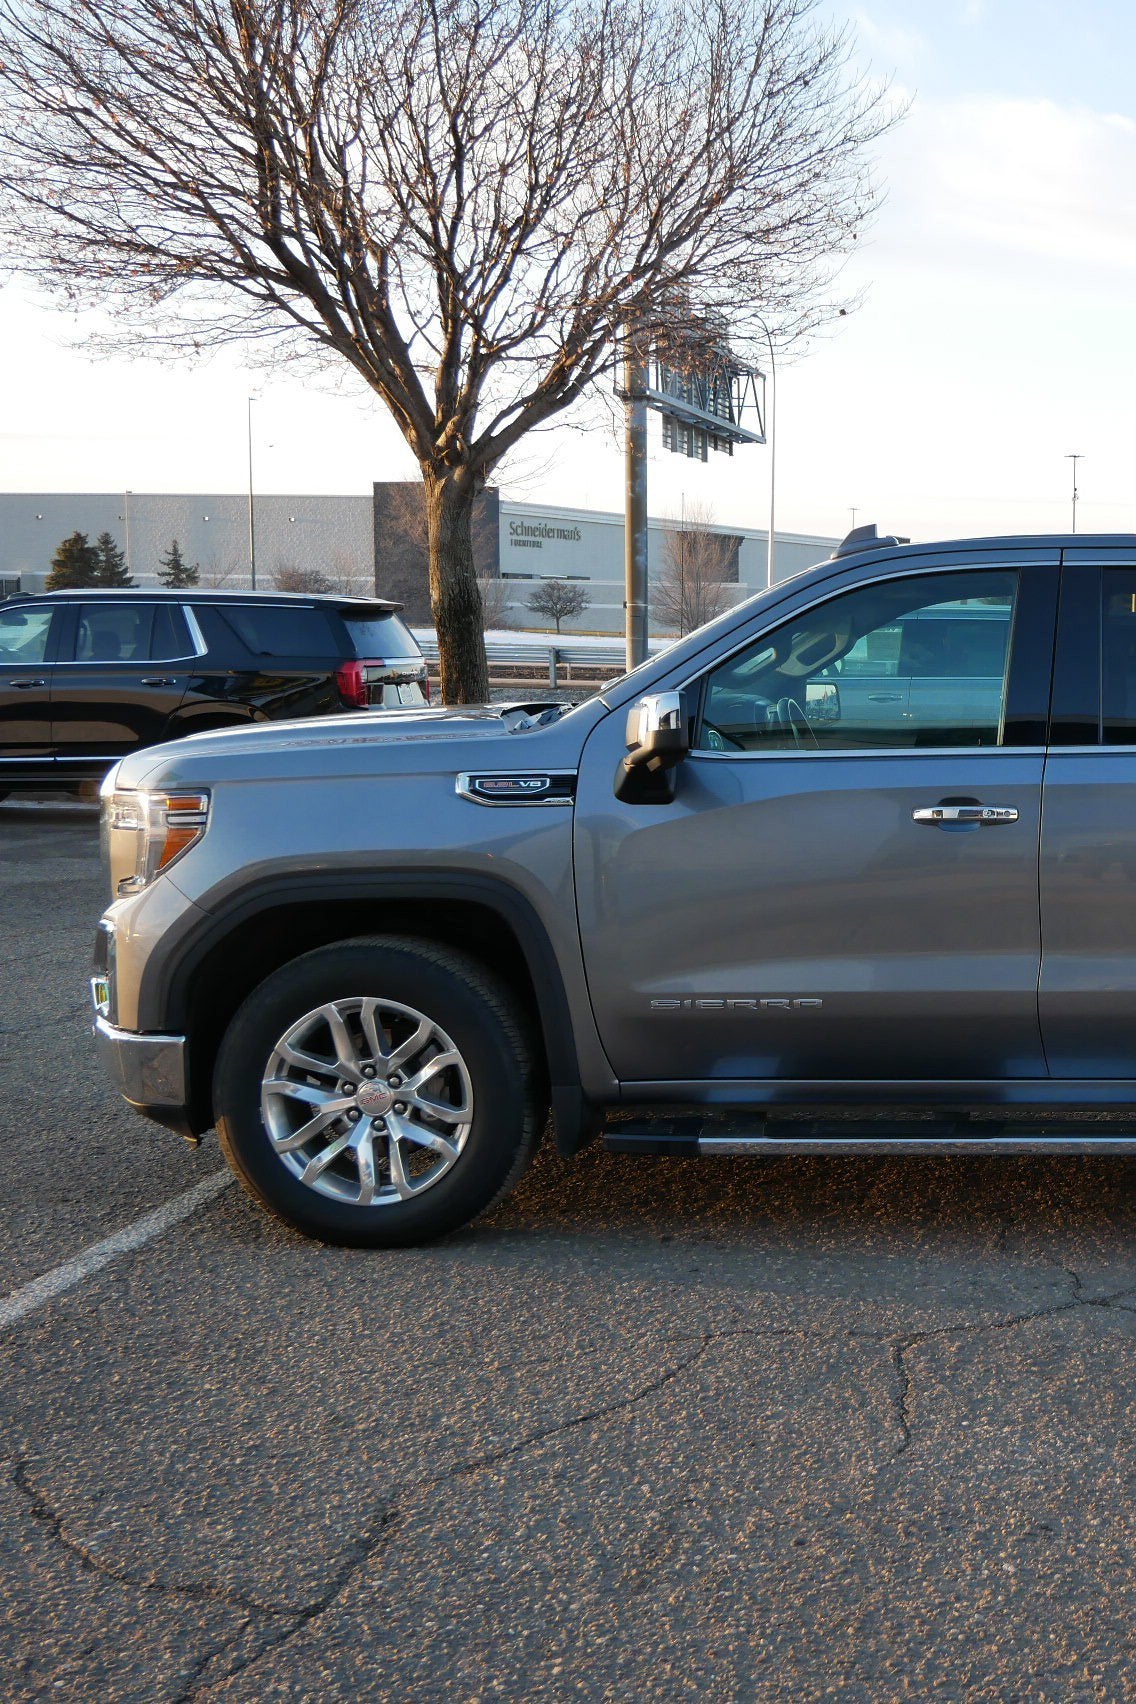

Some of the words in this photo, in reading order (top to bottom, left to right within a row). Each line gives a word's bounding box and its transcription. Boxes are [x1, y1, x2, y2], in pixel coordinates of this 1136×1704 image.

[509, 521, 581, 541] Schneiderman's
[650, 998, 823, 1010] SIERRA
[360, 1093, 386, 1105] GMC
